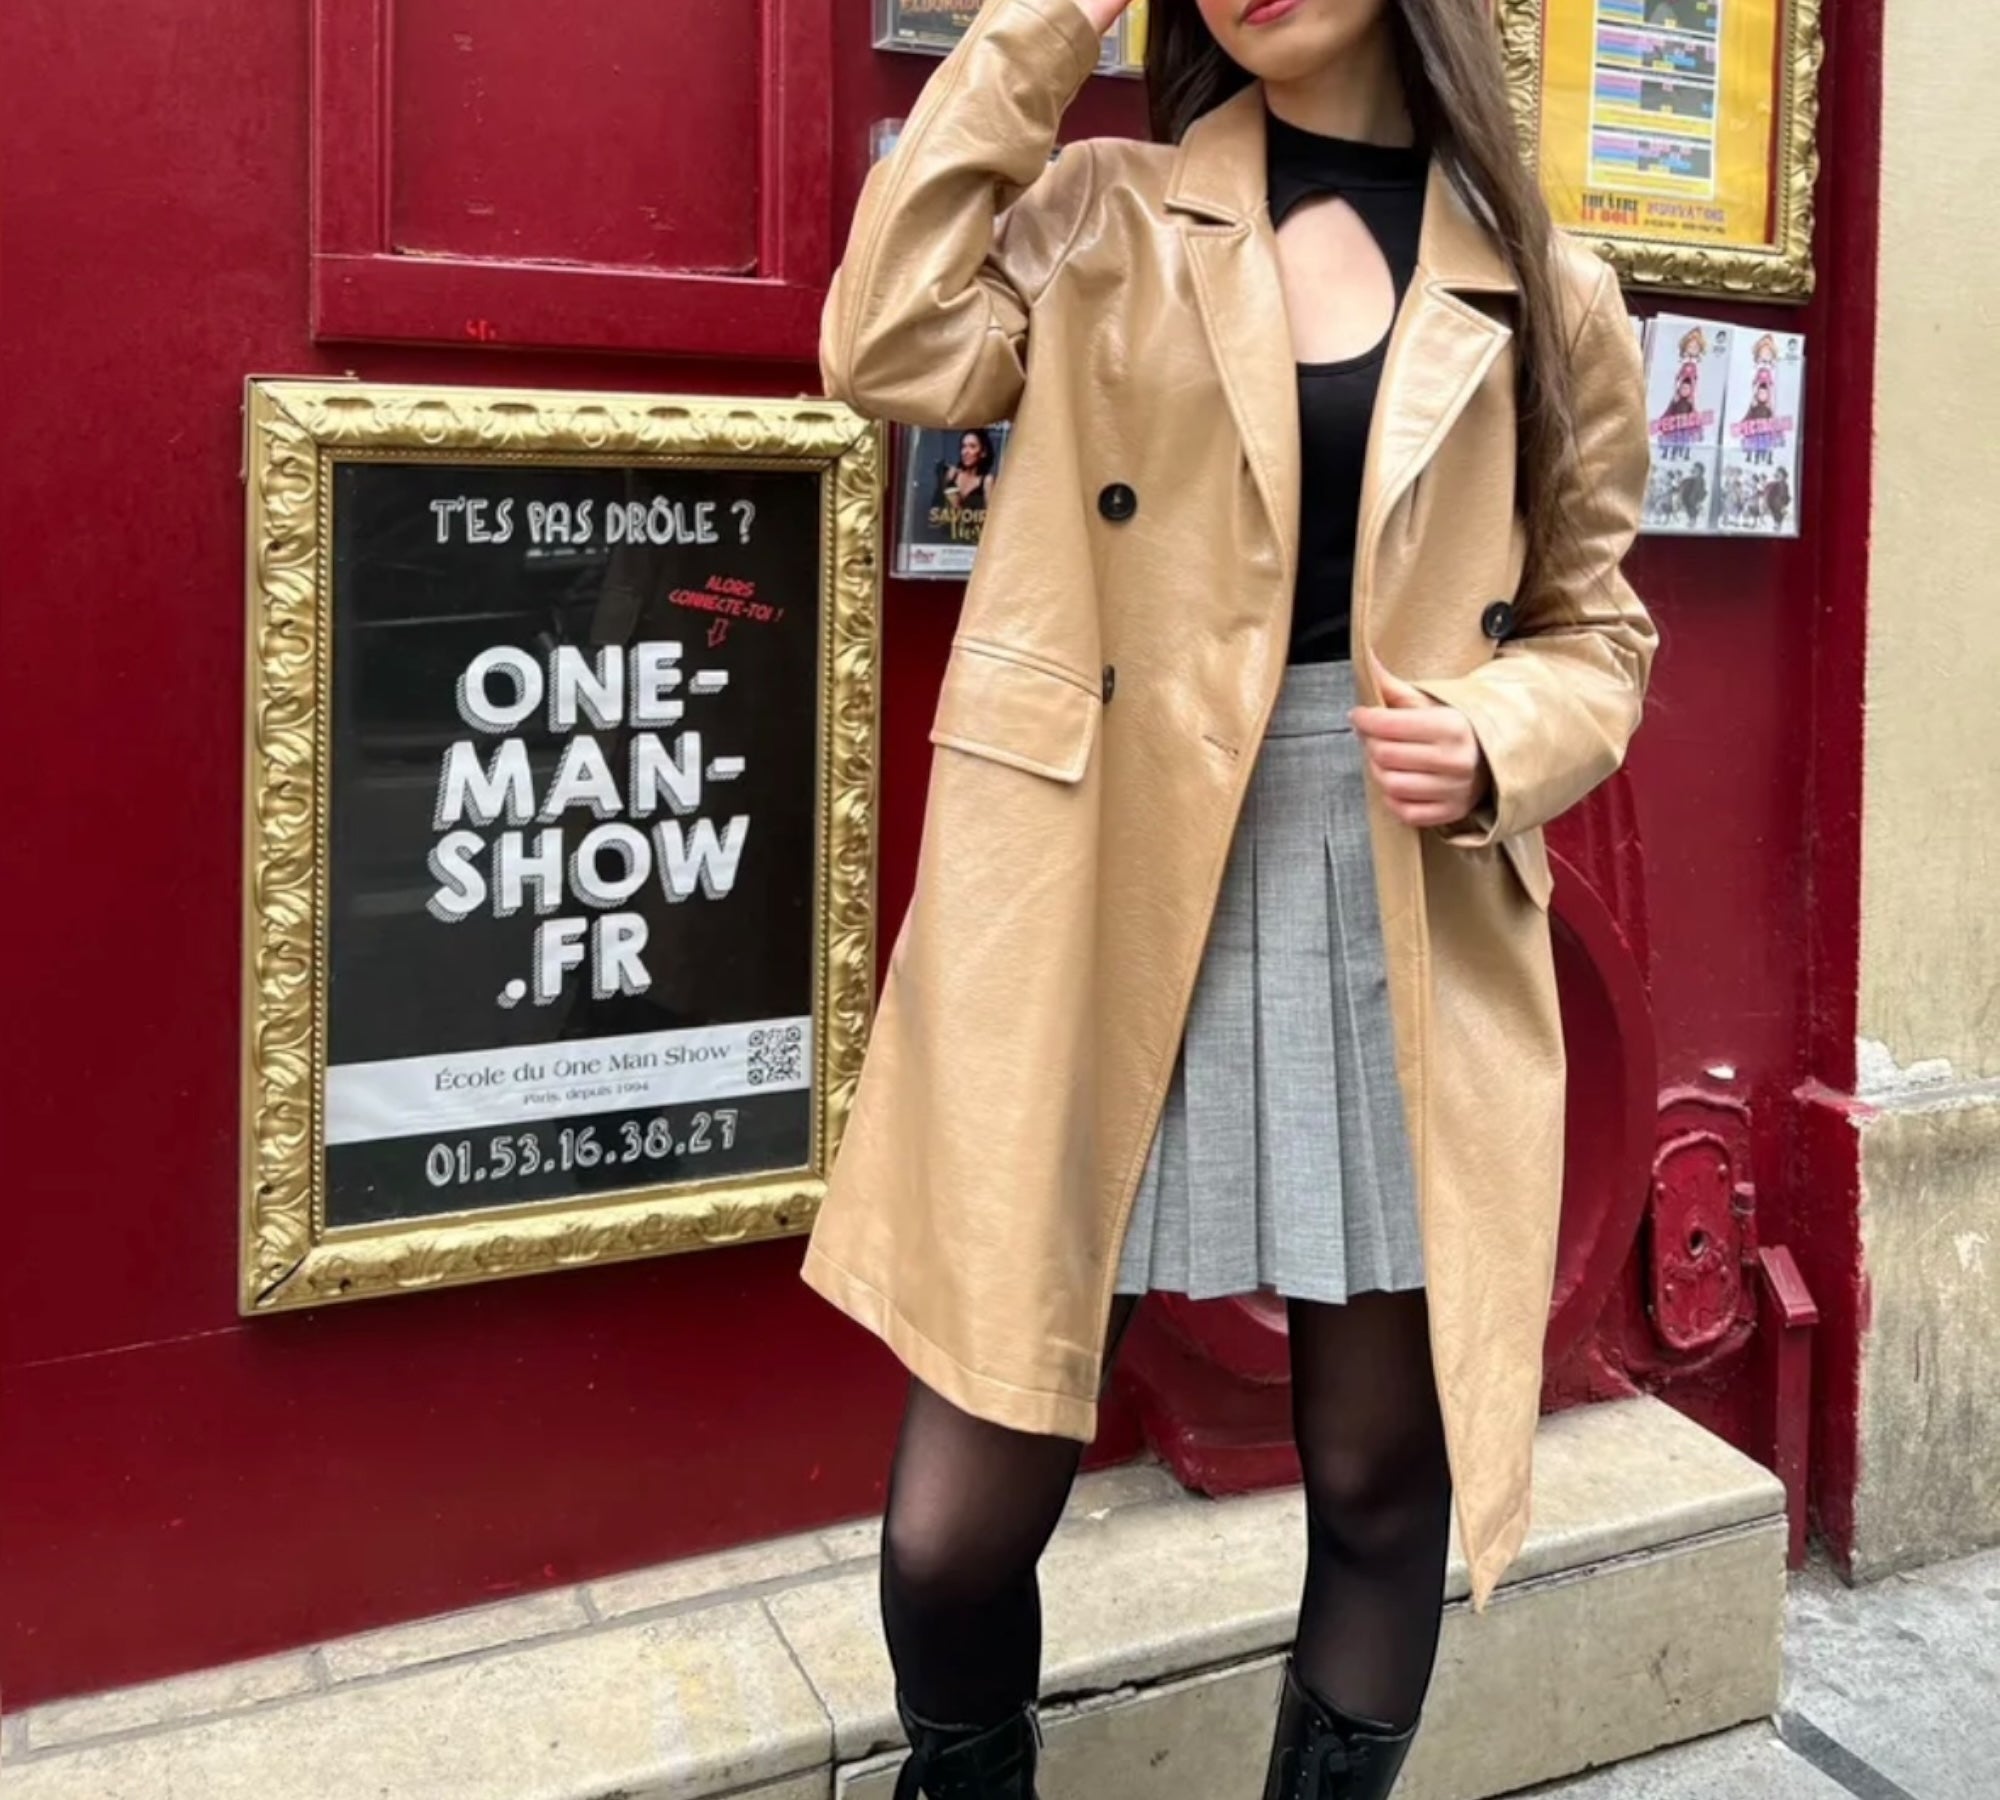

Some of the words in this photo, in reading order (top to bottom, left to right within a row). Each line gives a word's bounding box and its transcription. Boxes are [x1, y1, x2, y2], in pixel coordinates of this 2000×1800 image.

[527, 500, 593, 543] PAS
[606, 496, 718, 543] DRÔLE
[731, 501, 756, 543] ?
[668, 588, 774, 621] CONNECTE-TOI
[705, 575, 755, 598] ALORS
[456, 641, 729, 733] ONE-
[433, 731, 745, 831] MAN-
[426, 815, 750, 922] SHOW
[497, 912, 652, 1008] .FR
[434, 1067, 505, 1092] École
[513, 1062, 545, 1083] du
[553, 1058, 601, 1079] One
[608, 1051, 658, 1073] Man
[664, 1044, 731, 1067] Show
[566, 1086, 612, 1101] depuis
[617, 1081, 649, 1094] 1994
[426, 1109, 738, 1187] 01.53.16.38.27
